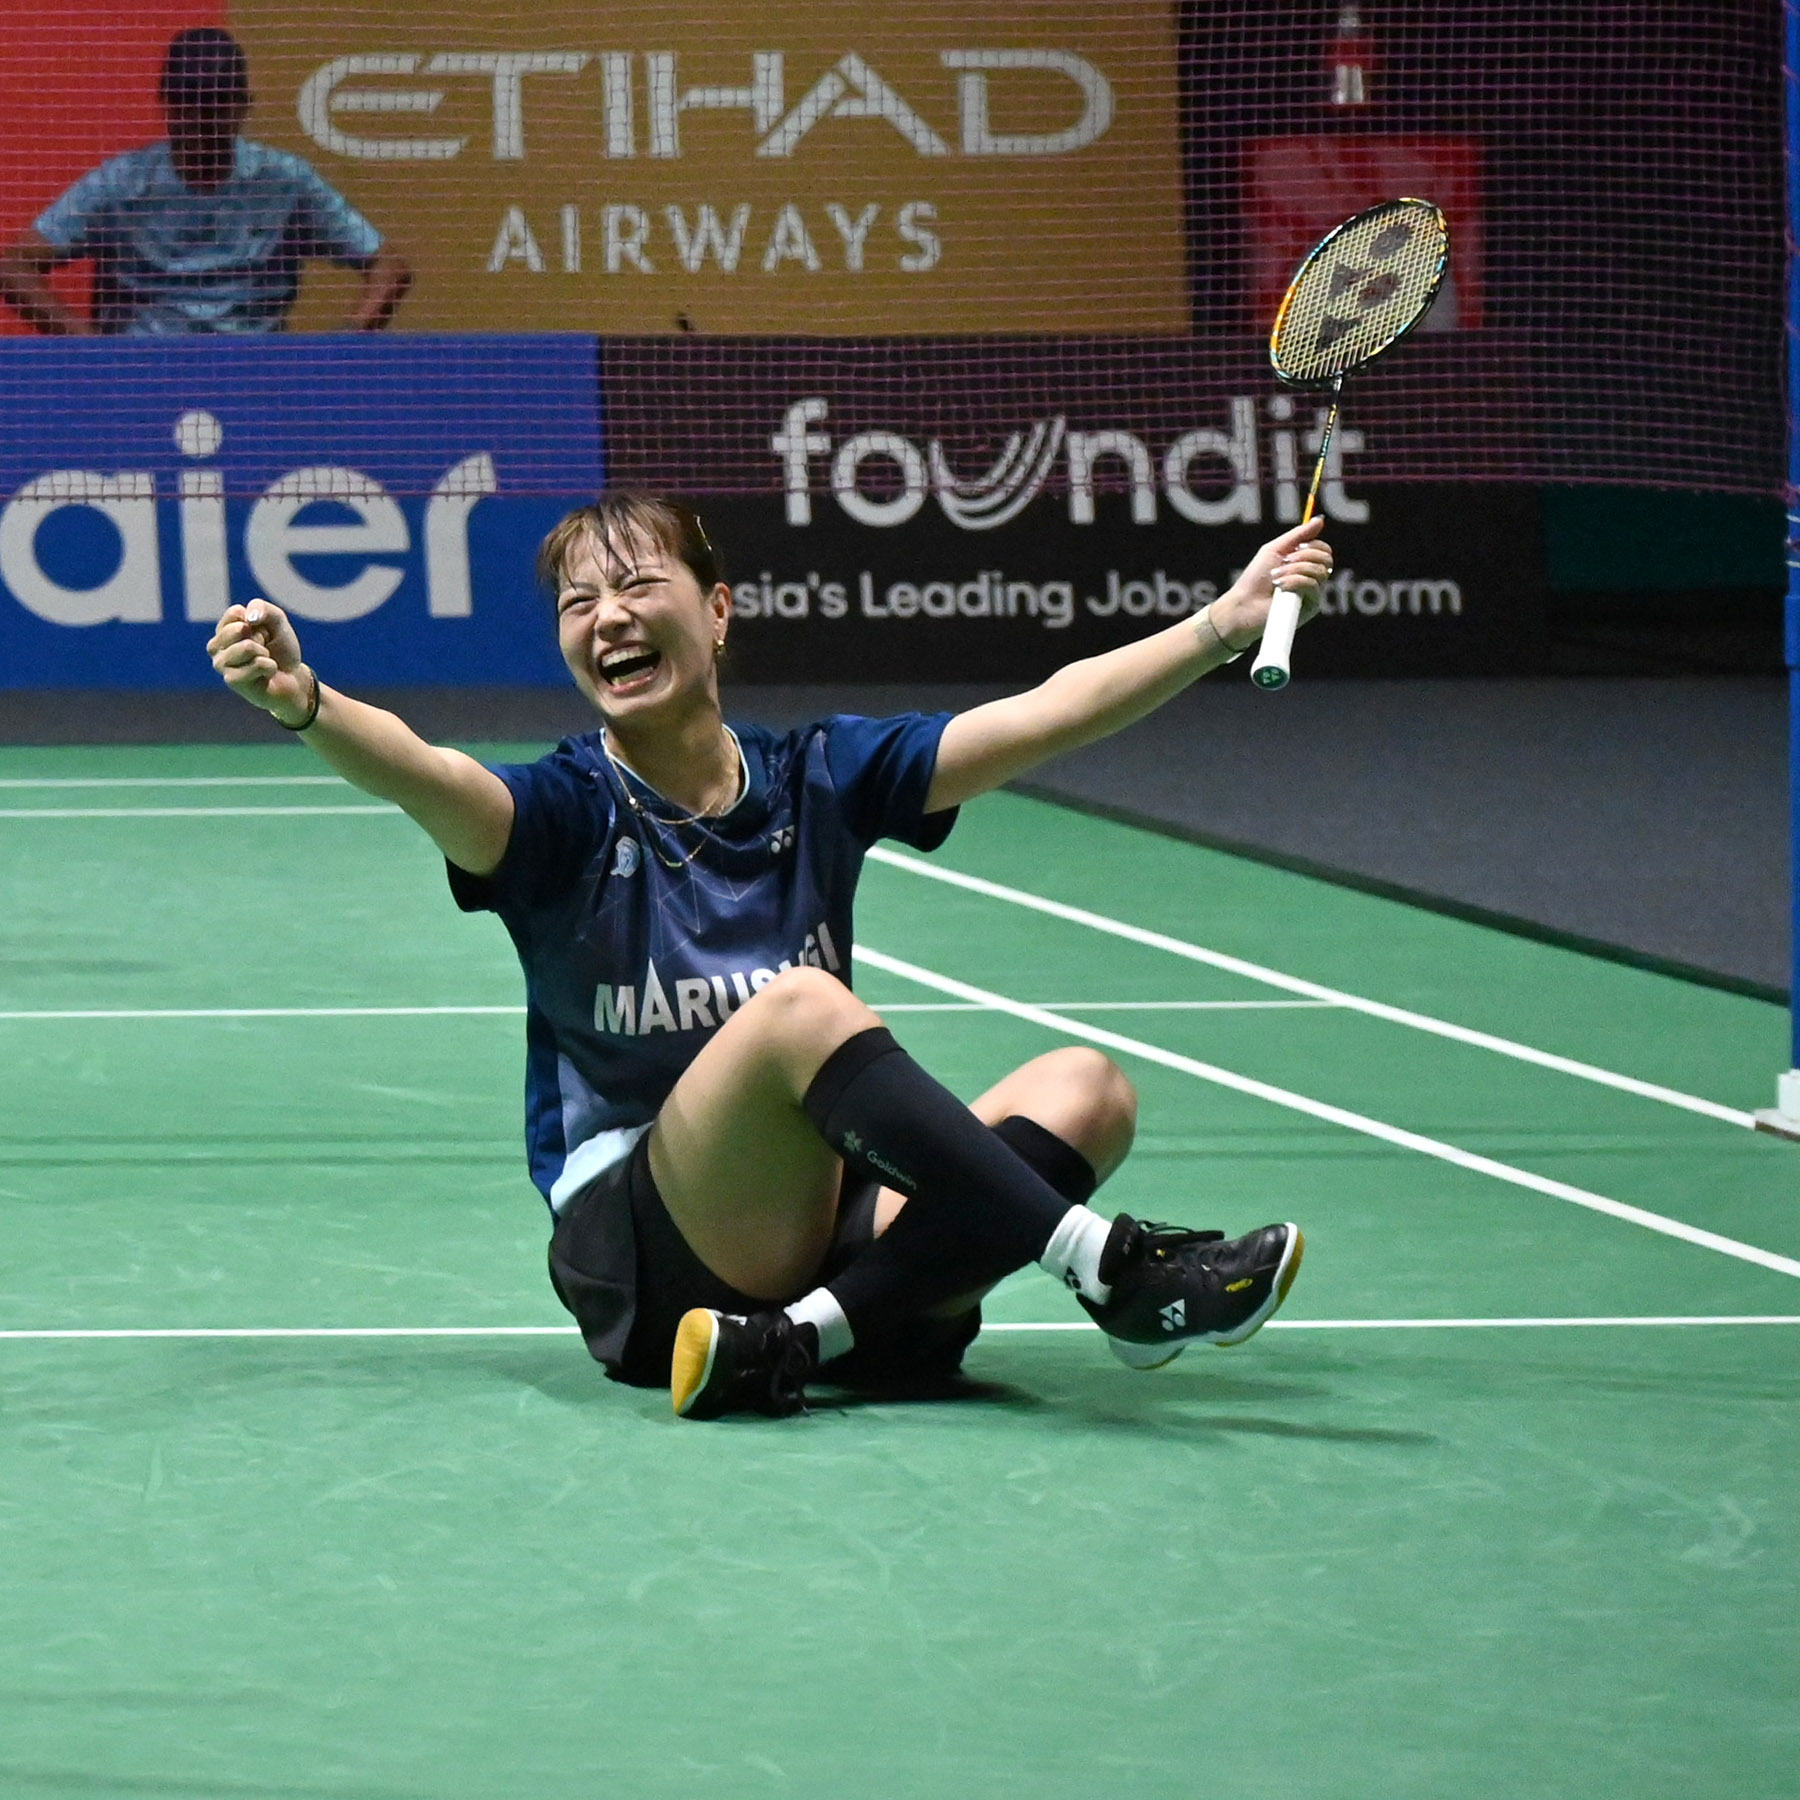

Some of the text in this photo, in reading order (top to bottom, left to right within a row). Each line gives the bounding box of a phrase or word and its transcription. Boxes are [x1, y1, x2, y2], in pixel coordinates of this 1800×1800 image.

[295, 47, 1117, 160] ETIHAD
[487, 201, 943, 275] AIRWAYS
[769, 396, 1371, 531] foundit
[732, 570, 849, 619] sia's
[858, 569, 1075, 630] Leading
[1085, 568, 1219, 617] Jobs
[866, 1150, 918, 1191] Goldwin
